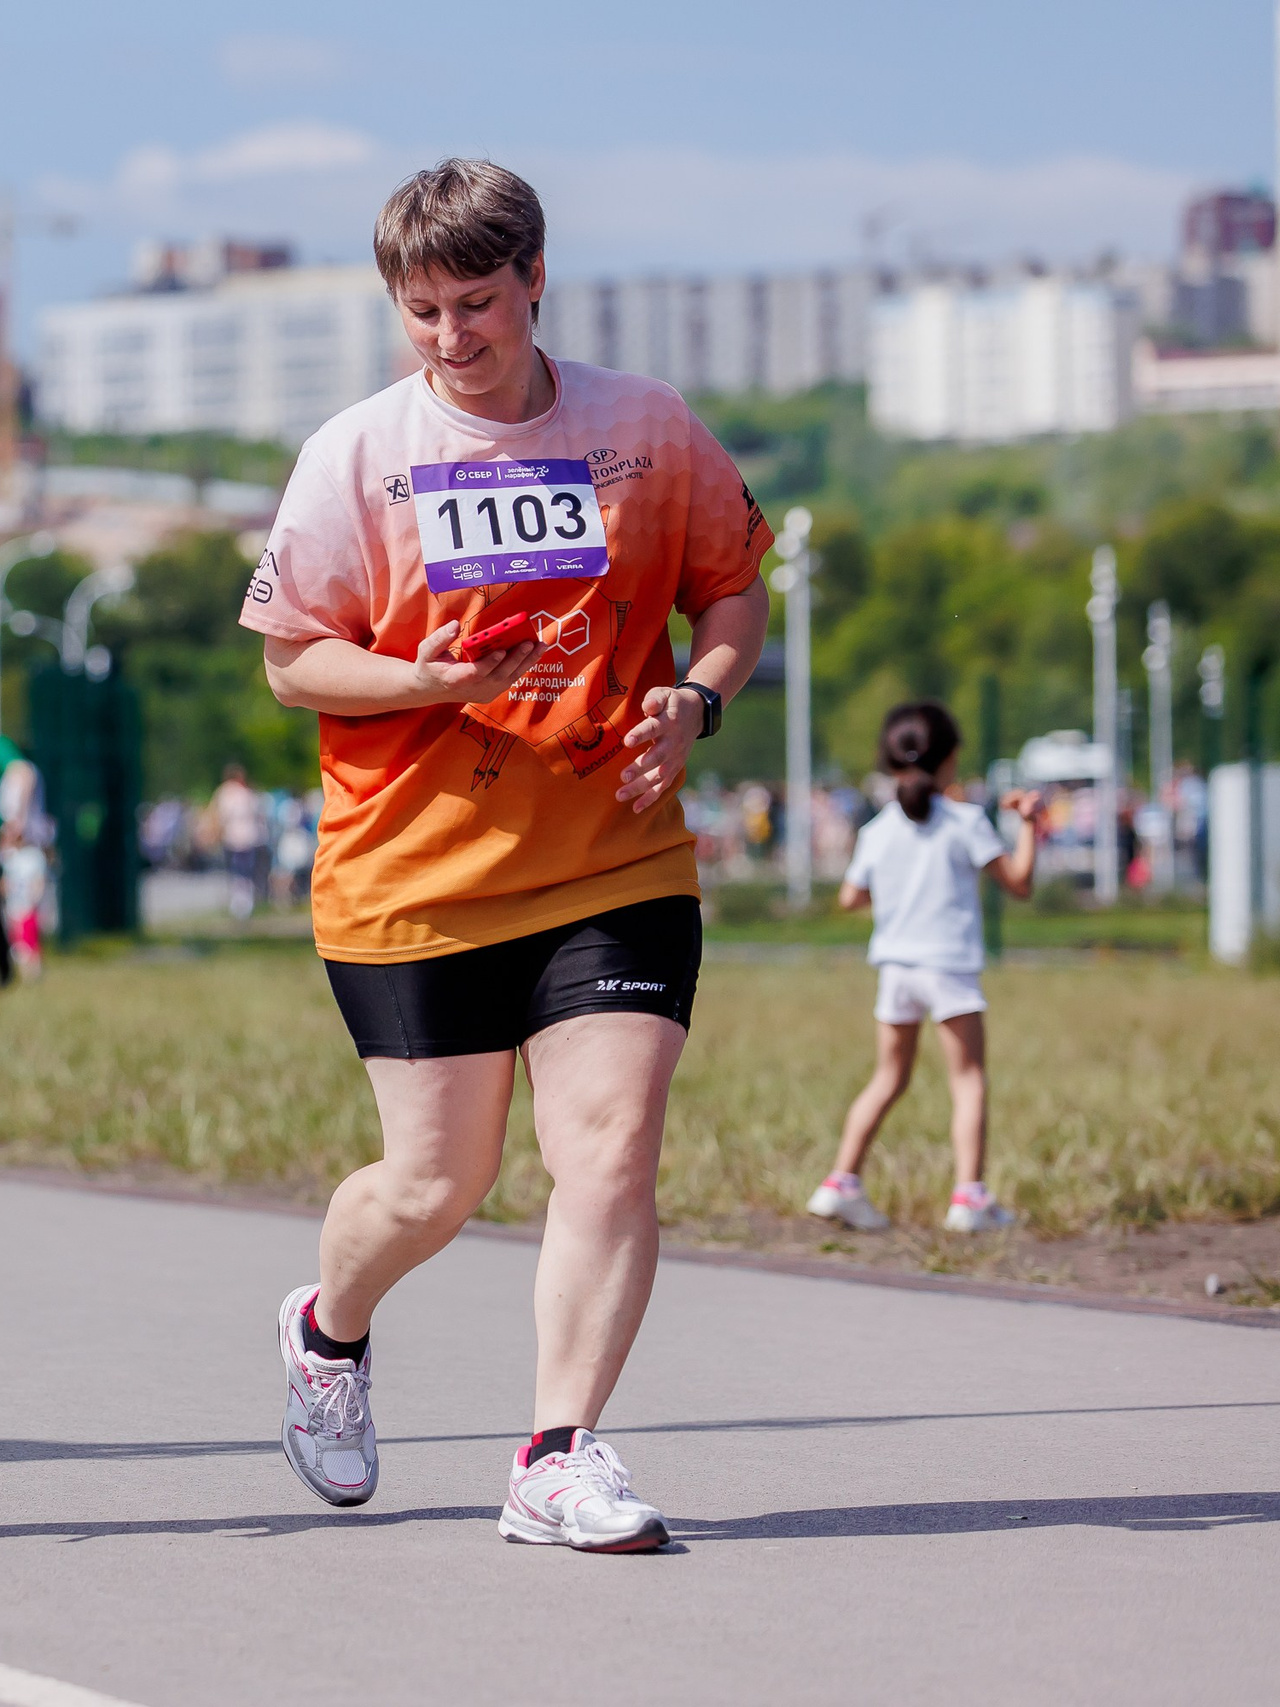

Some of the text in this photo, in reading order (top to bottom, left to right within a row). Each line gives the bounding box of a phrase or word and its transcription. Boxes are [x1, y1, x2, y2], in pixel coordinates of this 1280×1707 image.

[592, 450, 608, 462] SP
[468, 471, 493, 479] СБЕР
[438, 491, 587, 550] 1103
[526, 661, 564, 673] МСКИЙ
[508, 691, 561, 702] МАРАФОН
[621, 981, 667, 992] SPORT
